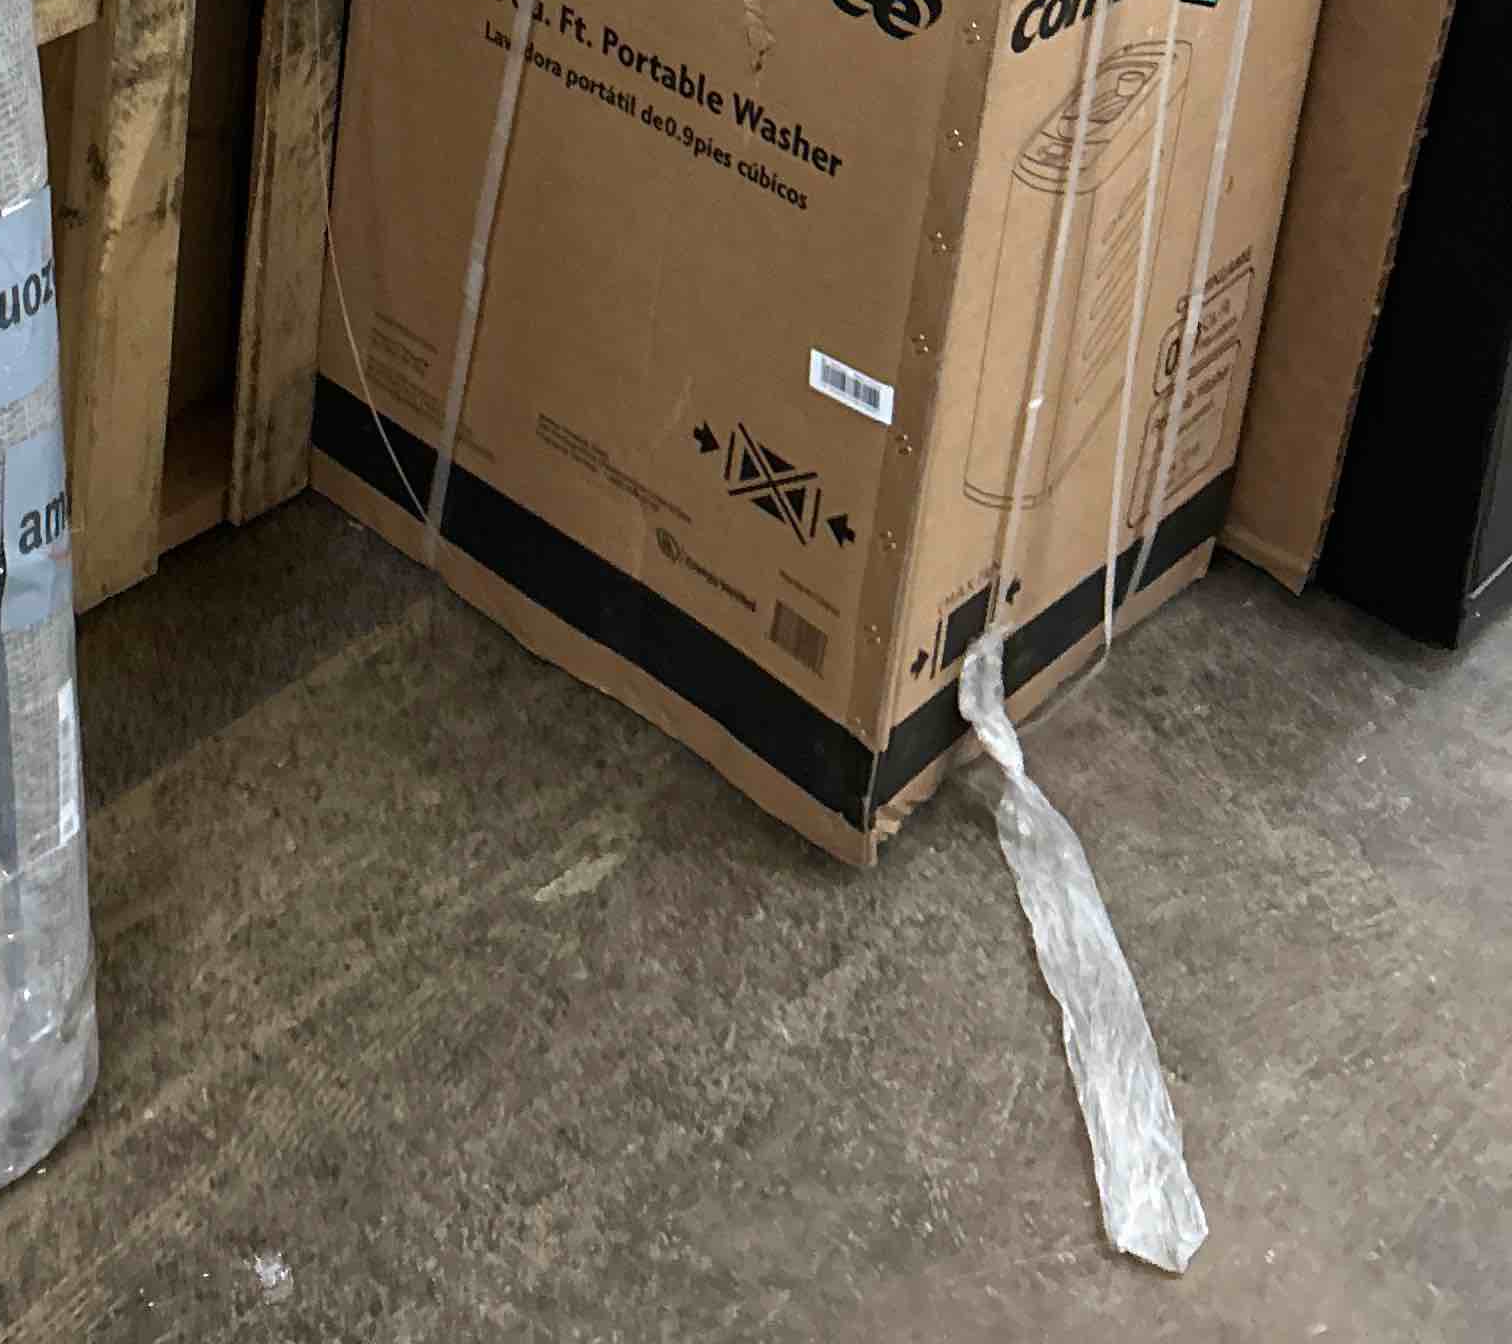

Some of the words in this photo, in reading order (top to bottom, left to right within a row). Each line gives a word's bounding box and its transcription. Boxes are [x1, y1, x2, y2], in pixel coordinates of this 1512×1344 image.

[559, 4, 593, 49] Ft.
[601, 25, 724, 115] Portable
[732, 91, 843, 178] Washer
[565, 67, 636, 118] portátil
[737, 159, 808, 210] cúbicos
